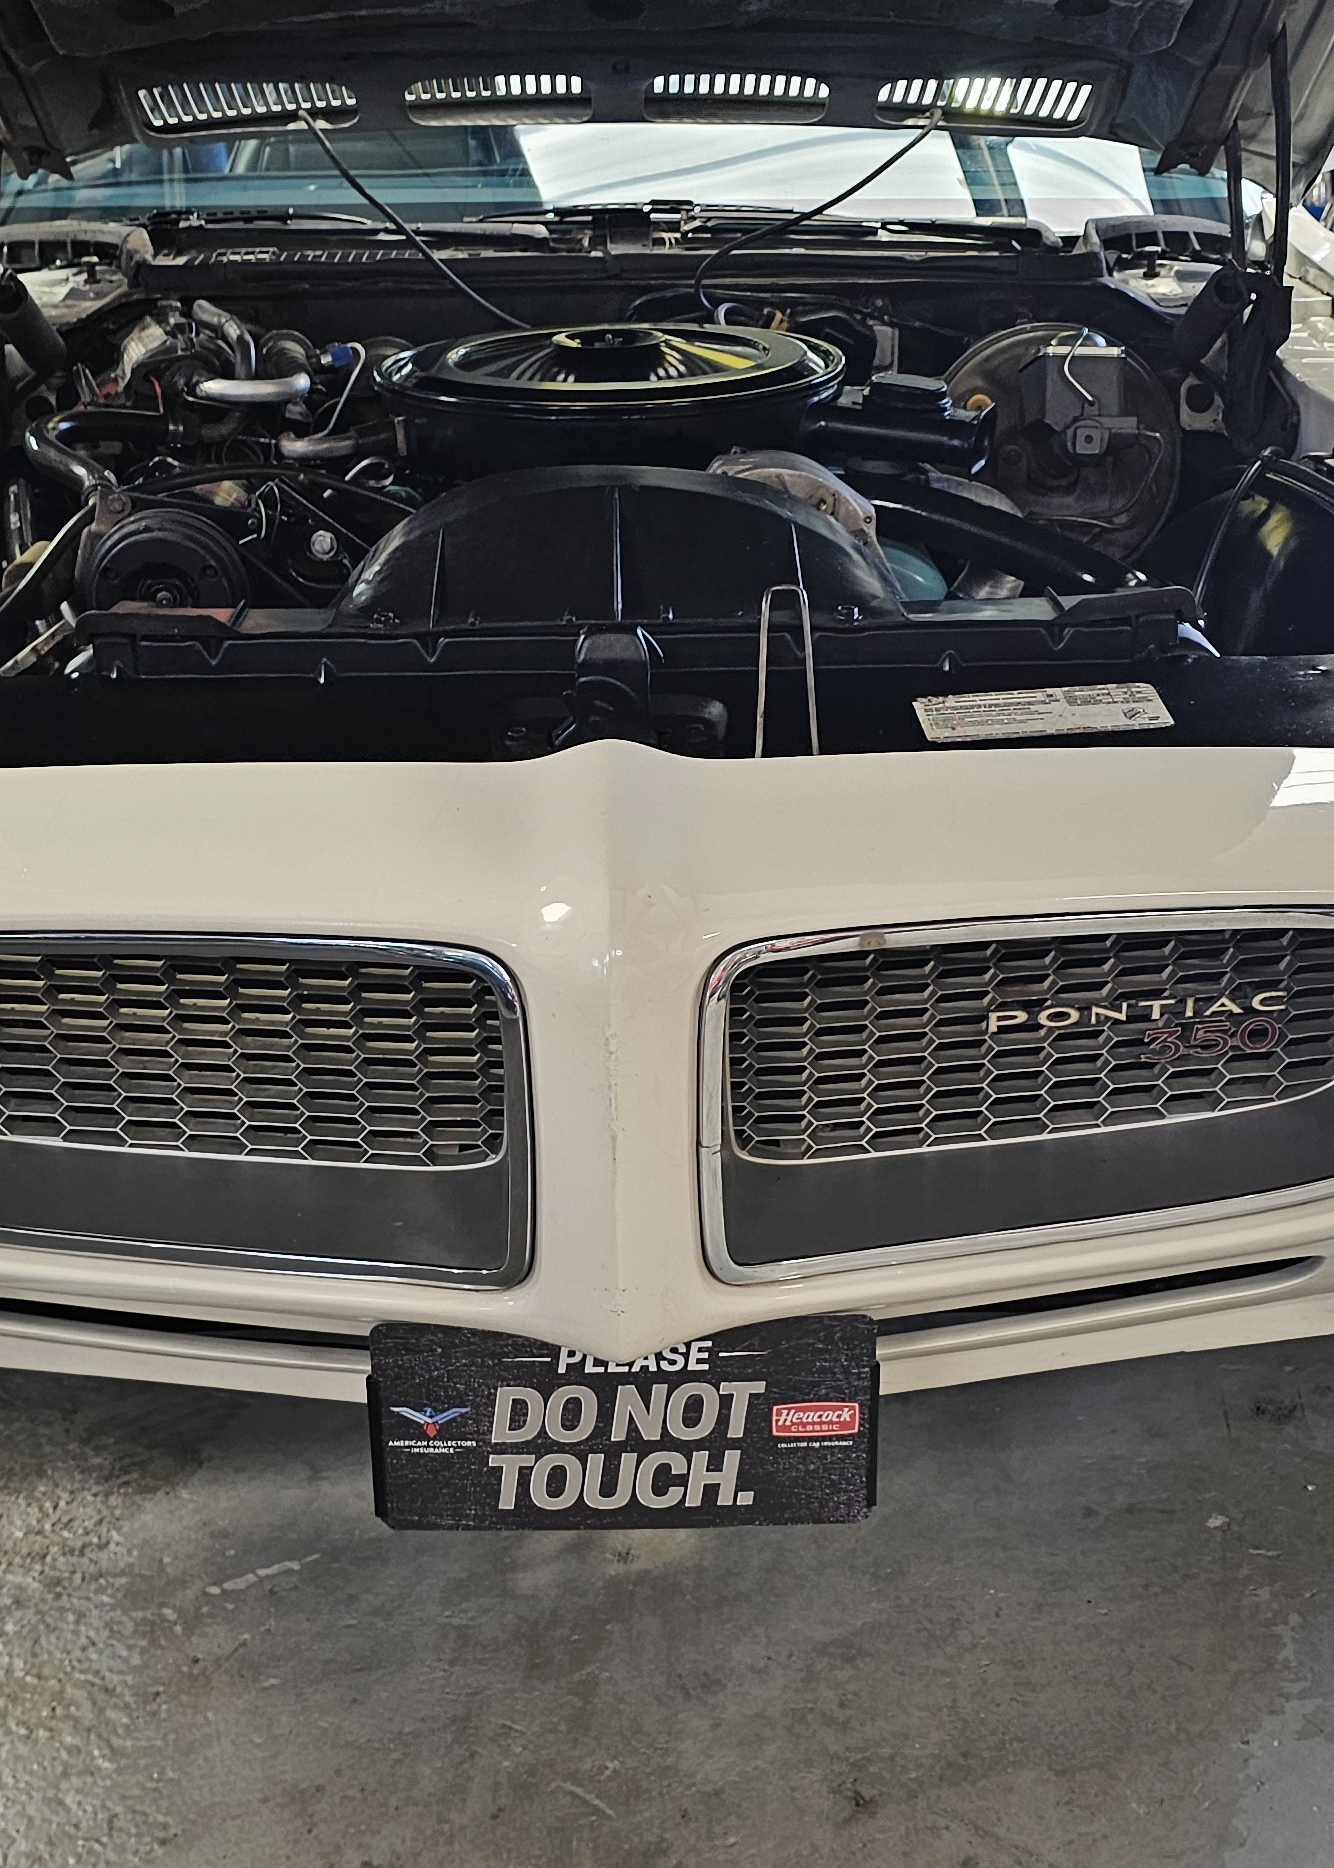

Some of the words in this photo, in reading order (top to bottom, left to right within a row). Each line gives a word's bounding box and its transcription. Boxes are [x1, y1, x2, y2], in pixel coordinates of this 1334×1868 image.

[987, 991, 1287, 1033] PONTIAC
[1141, 1017, 1279, 1062] 350
[491, 1384, 598, 1443] DO
[610, 1381, 766, 1441] NOT
[778, 1408, 854, 1426] Heacock
[488, 1450, 755, 1510] TOUCH.
